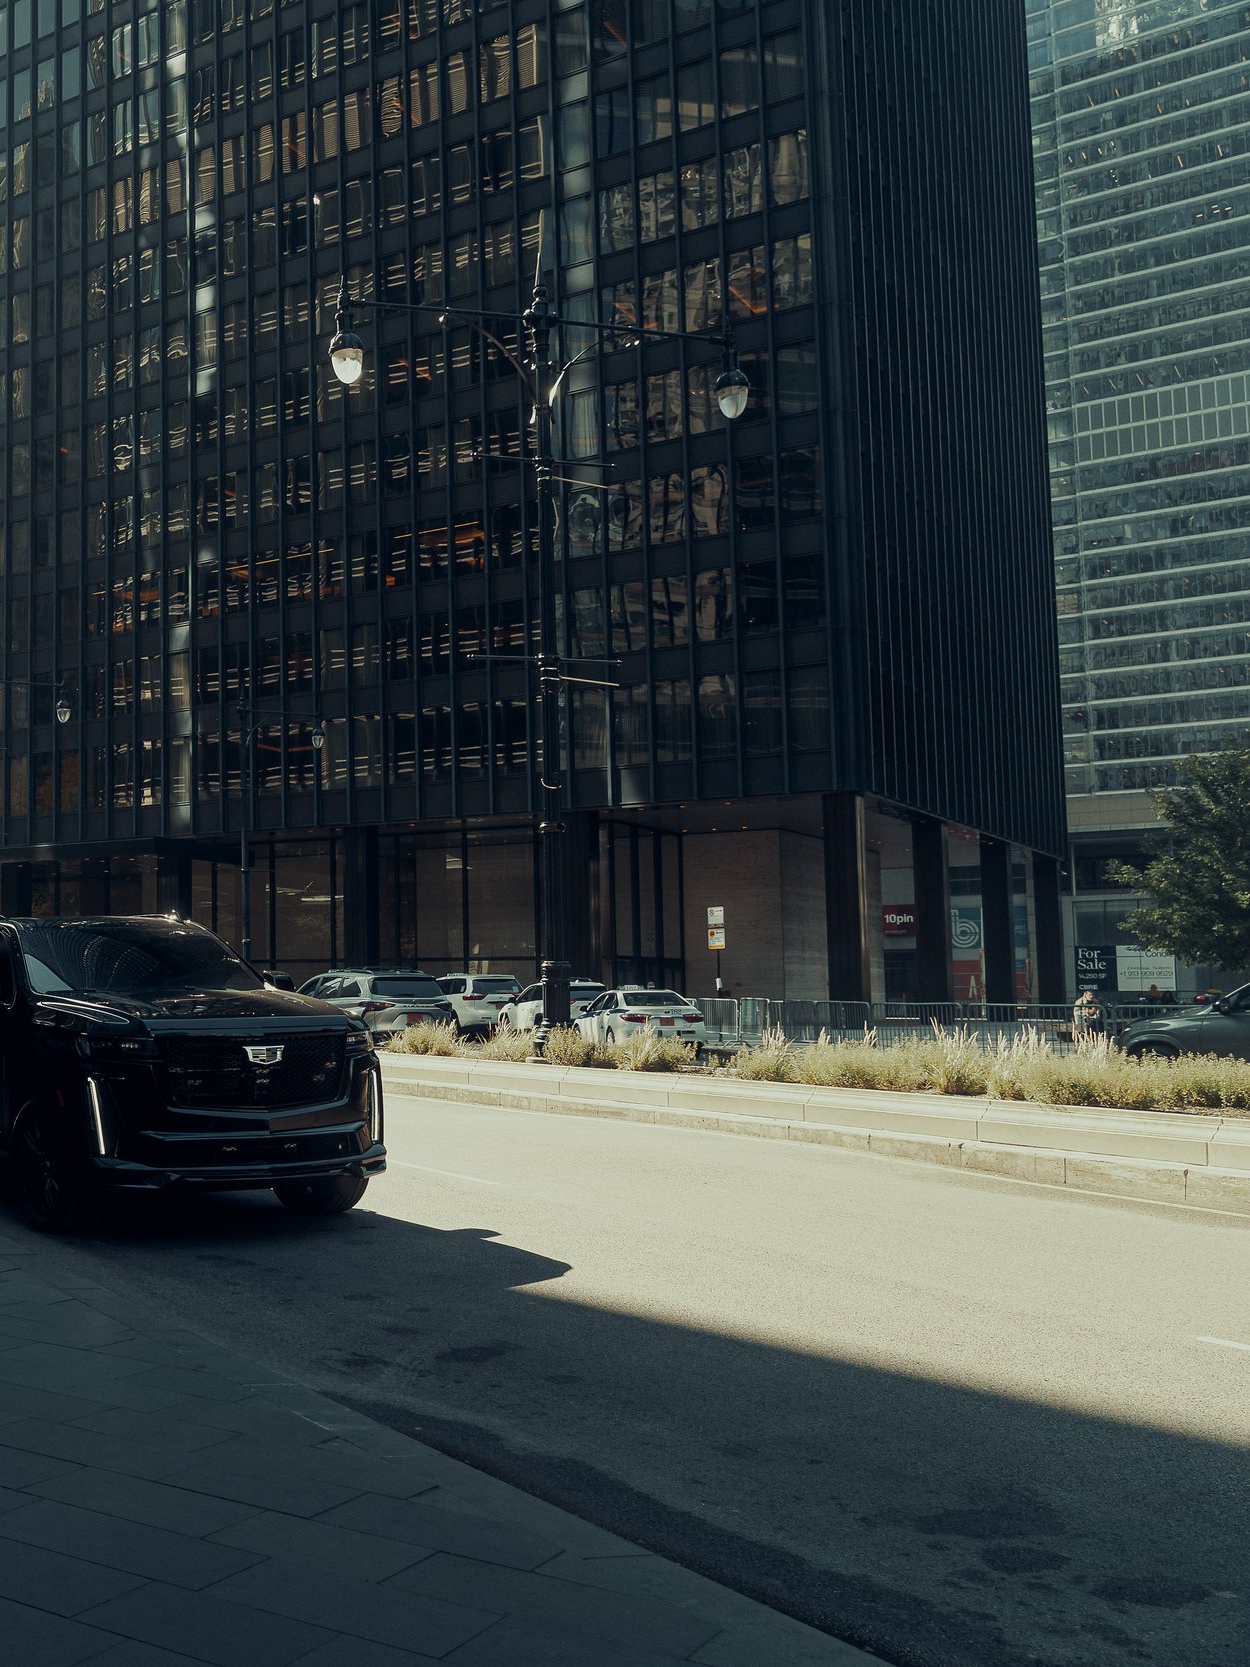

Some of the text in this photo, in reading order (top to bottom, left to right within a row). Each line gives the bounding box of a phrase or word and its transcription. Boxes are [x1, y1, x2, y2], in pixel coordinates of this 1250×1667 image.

[884, 914, 914, 925] 10pin
[1078, 948, 1100, 959] For
[1077, 959, 1107, 970] Sale
